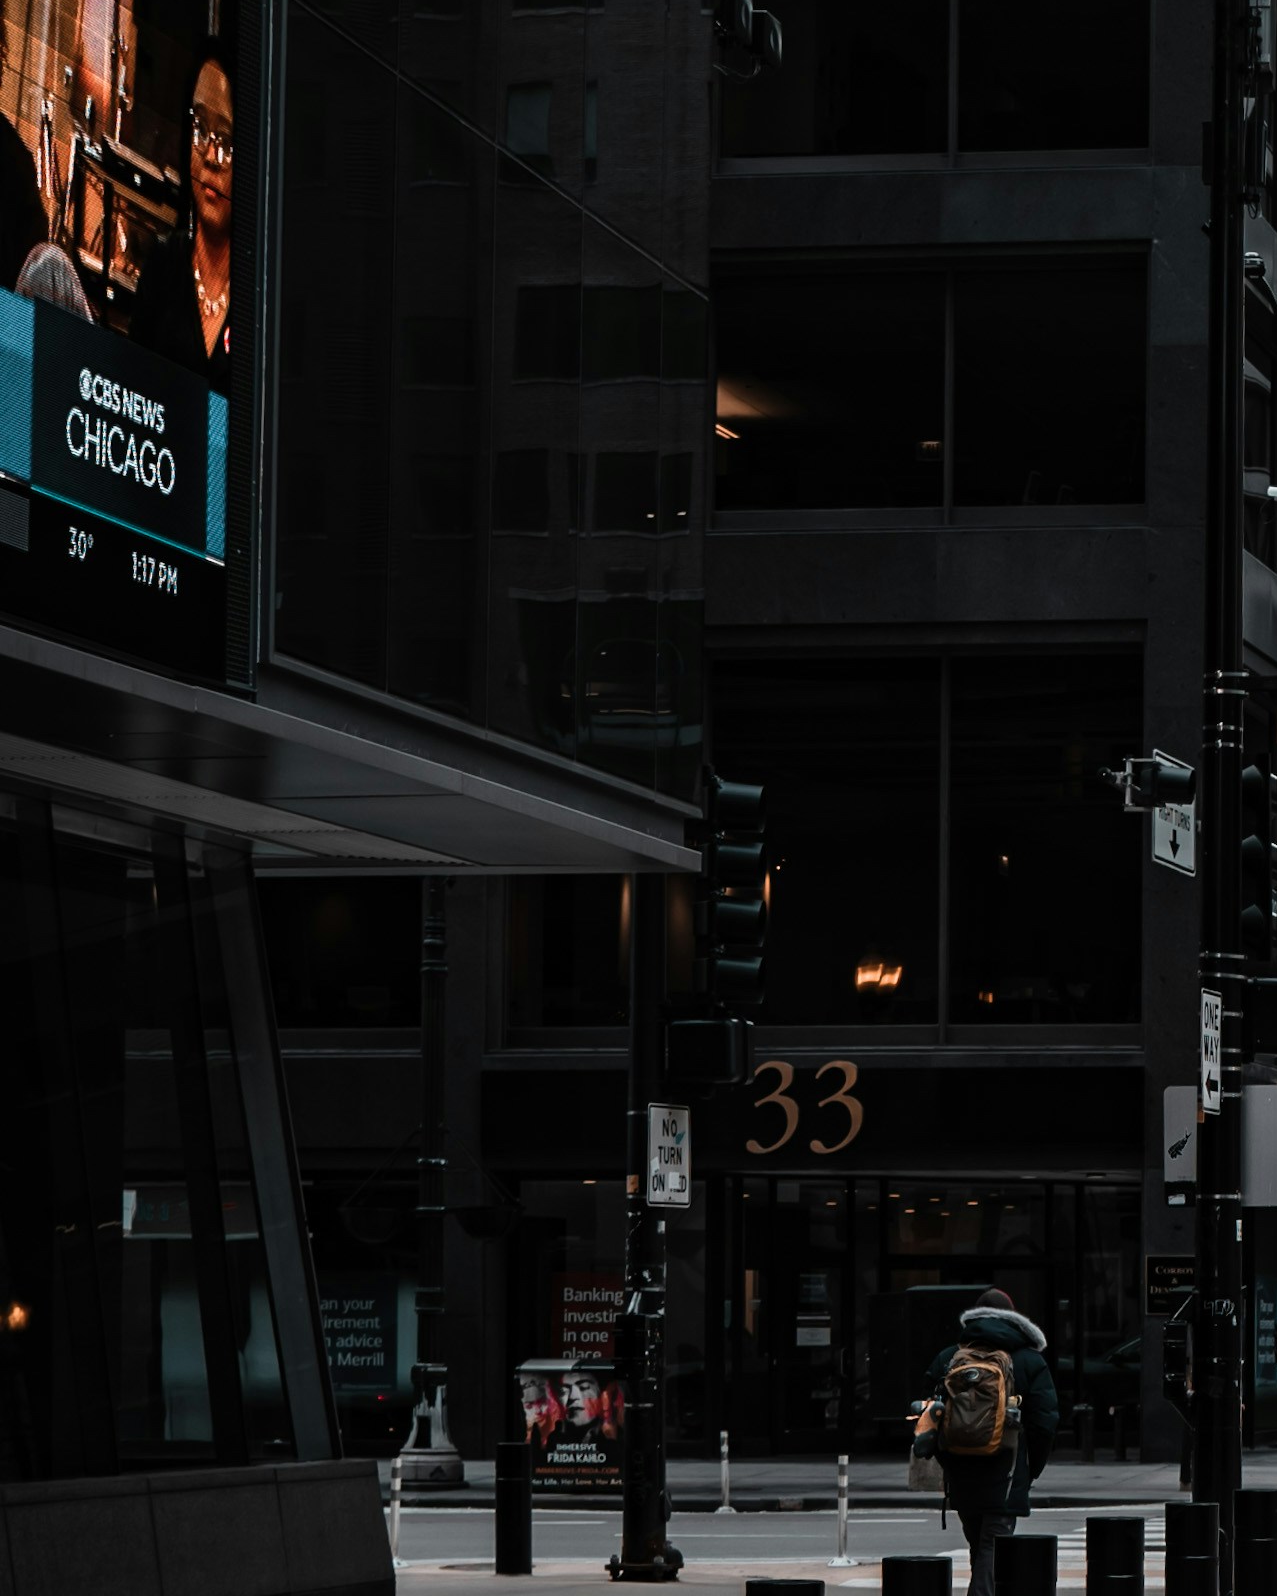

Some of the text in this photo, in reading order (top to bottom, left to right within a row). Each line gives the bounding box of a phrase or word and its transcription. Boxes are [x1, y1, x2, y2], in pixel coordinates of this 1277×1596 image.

[93, 373, 165, 435] CBS NEWS
[66, 406, 176, 496] CHICAGO
[68, 526, 94, 561] 30°
[131, 551, 178, 596] 1:17 PM
[1203, 1001, 1219, 1031] ONE
[1203, 1035, 1220, 1064] WAY
[746, 1060, 864, 1155] 33
[662, 1119, 677, 1137] NO
[658, 1145, 682, 1164] TURN
[652, 1172, 665, 1192] ON
[563, 1287, 624, 1306] Banking
[321, 1298, 376, 1315] an your
[563, 1309, 623, 1323] investin
[323, 1315, 381, 1330] irement
[336, 1332, 383, 1348] advice
[563, 1328, 609, 1343] in one
[337, 1351, 385, 1367] Merrill
[556, 1443, 598, 1452] IMMERSIVE
[547, 1452, 607, 1464] FRIDA KAHLO
